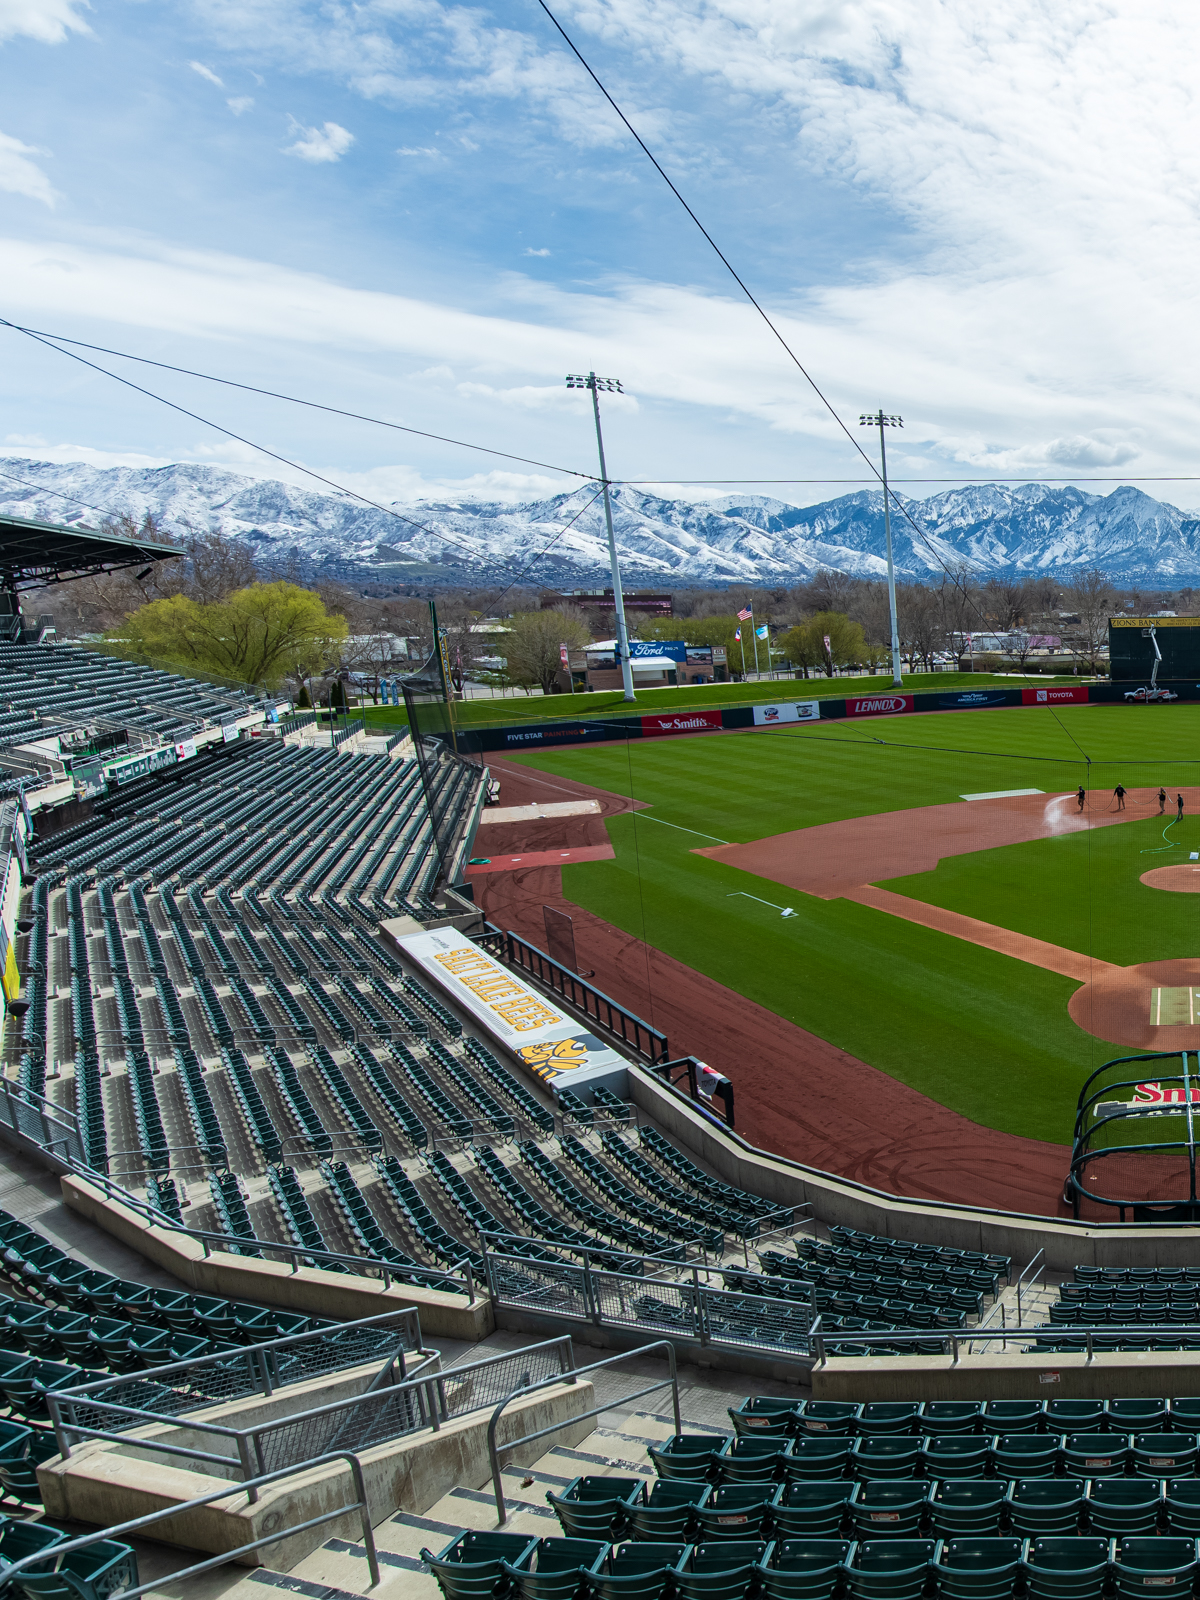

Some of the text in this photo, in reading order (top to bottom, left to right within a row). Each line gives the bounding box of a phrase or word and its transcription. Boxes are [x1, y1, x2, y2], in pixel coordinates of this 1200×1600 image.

[1112, 619, 1136, 627] ZIONS
[635, 643, 663, 656] Ford
[855, 699, 897, 713] LENNOX
[674, 718, 708, 729] Smith's
[507, 733, 524, 741] FIVE
[524, 732, 543, 740] STAR
[543, 729, 579, 738] PAINTING
[434, 948, 562, 1032] SALT LAKE BEES
